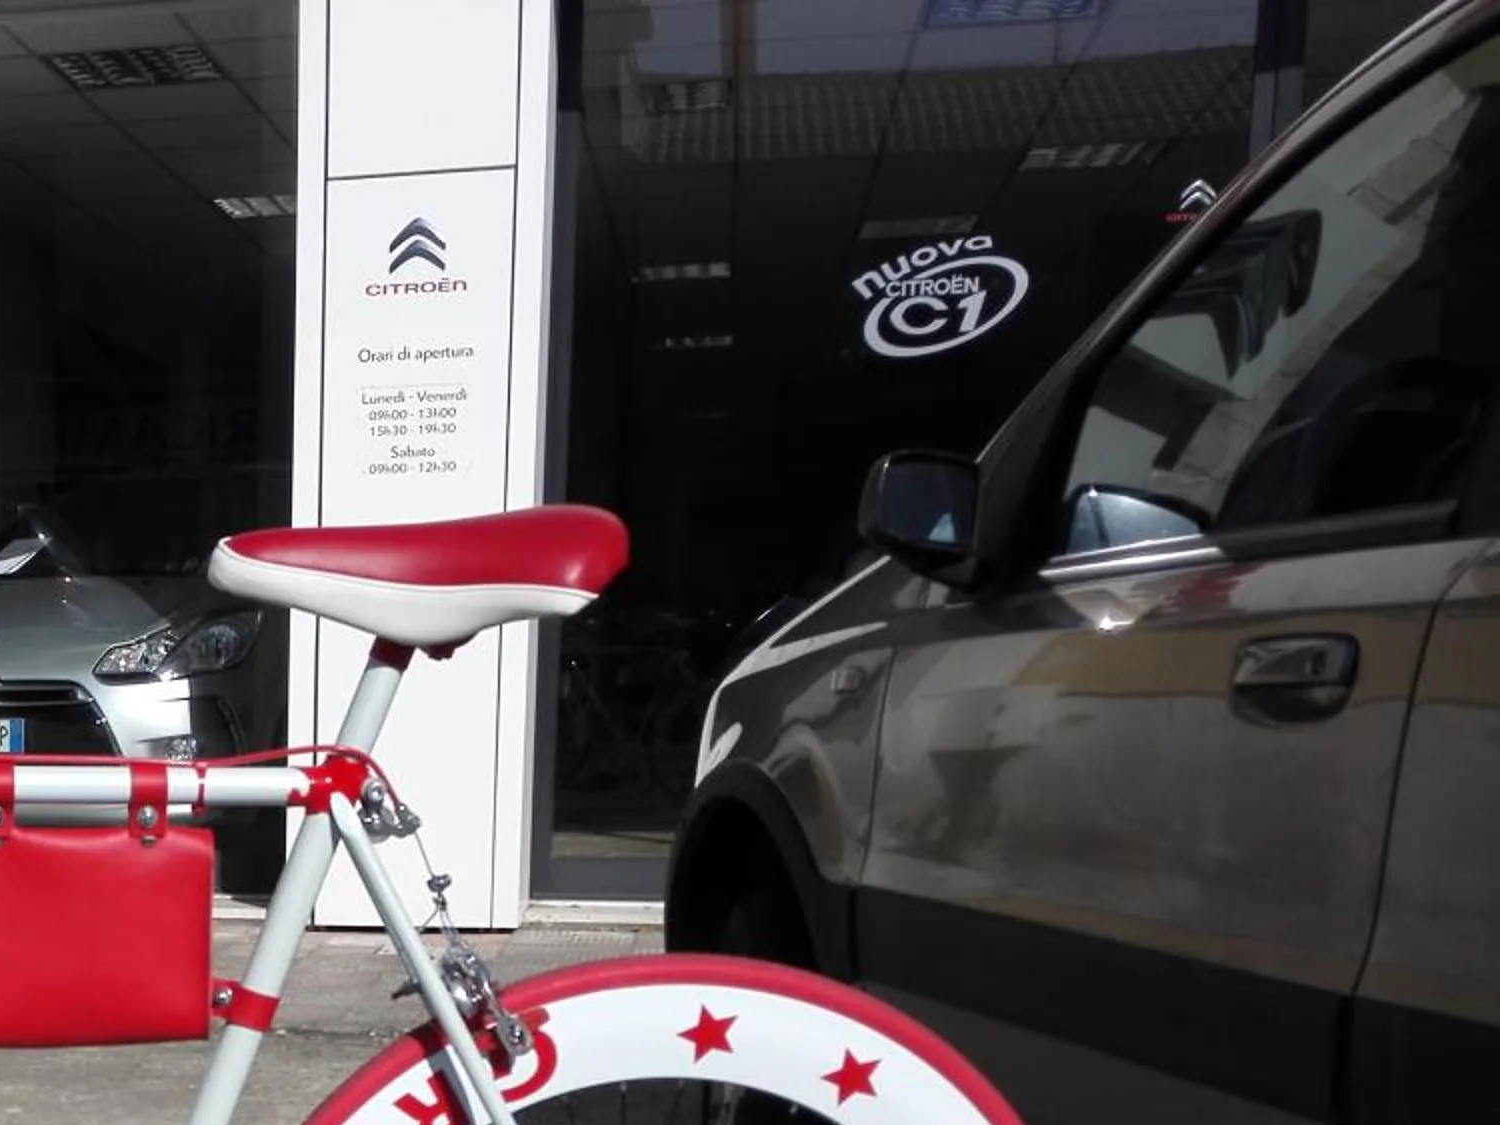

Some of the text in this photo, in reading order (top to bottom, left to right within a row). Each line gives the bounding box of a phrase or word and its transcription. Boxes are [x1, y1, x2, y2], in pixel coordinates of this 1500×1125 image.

[852, 235, 993, 299] nuova
[885, 274, 980, 298] CITROËN
[889, 290, 987, 335] C1
[358, 345, 474, 364] Orari di apertura
[390, 444, 436, 459] Sabato
